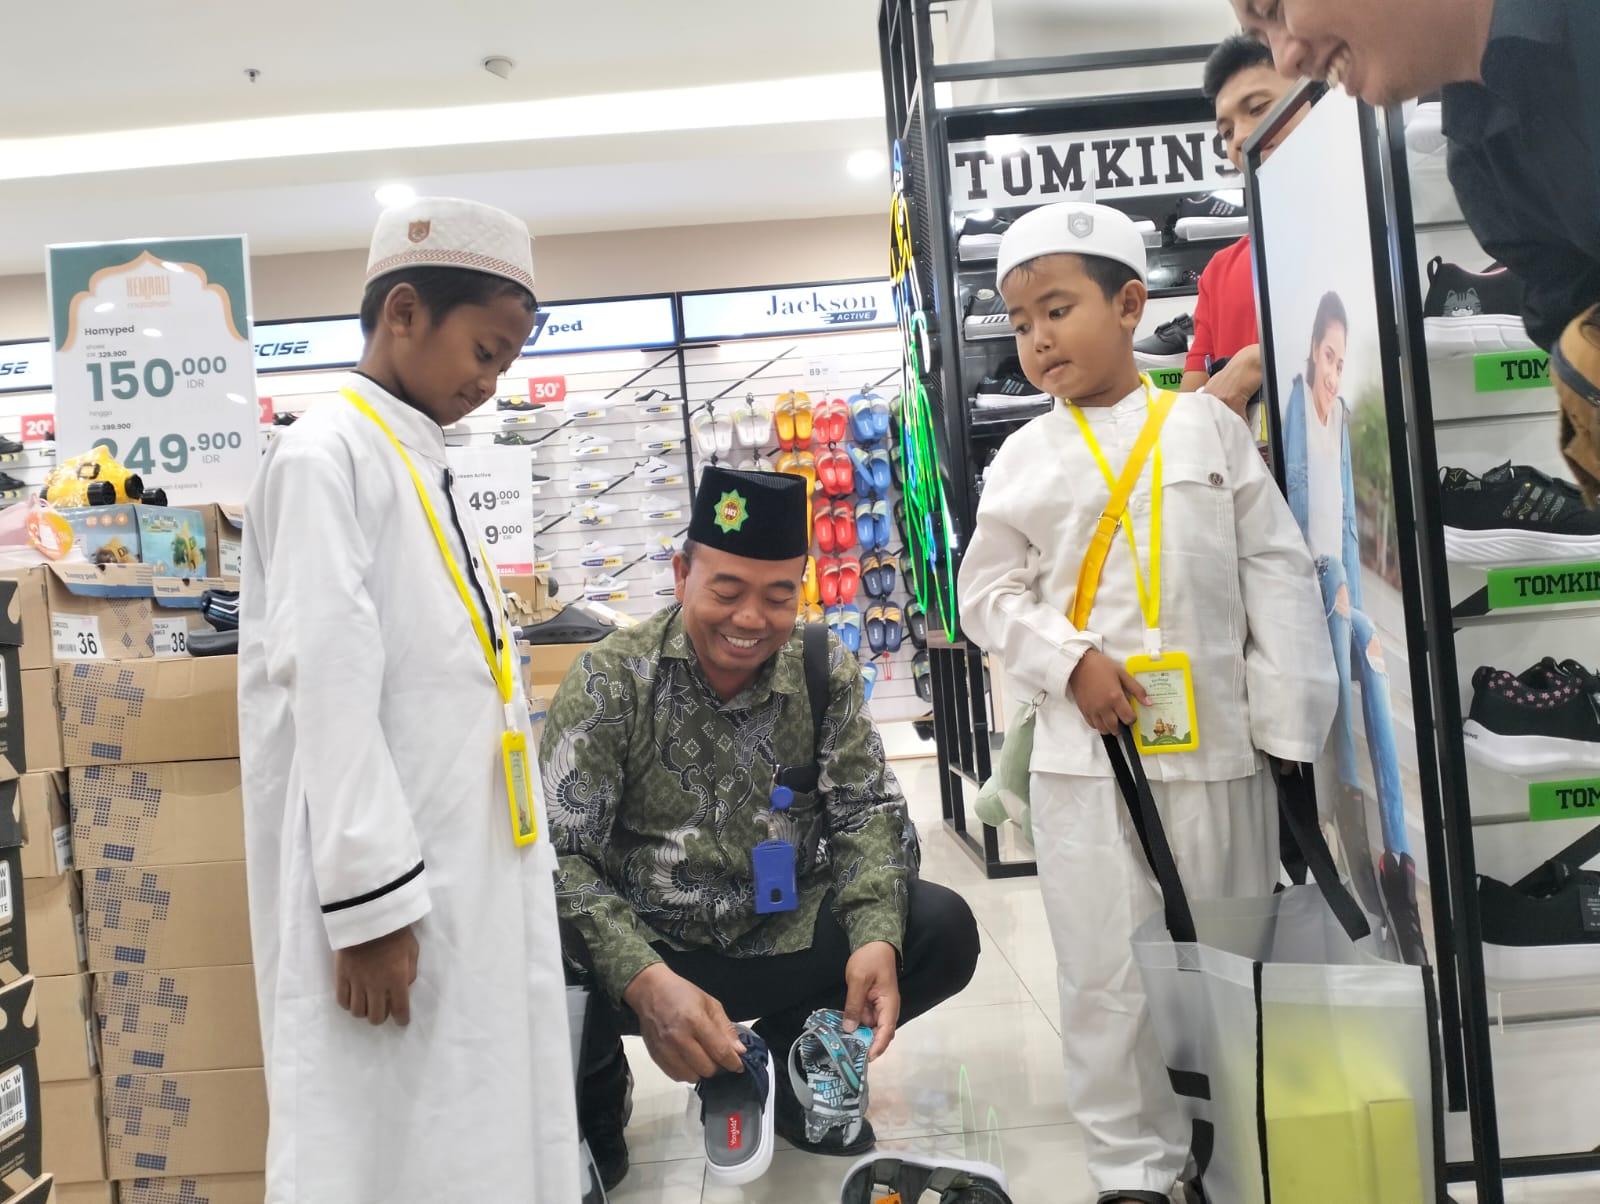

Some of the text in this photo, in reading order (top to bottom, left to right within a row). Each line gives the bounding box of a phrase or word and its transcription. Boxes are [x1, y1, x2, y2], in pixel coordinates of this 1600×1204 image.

[954, 131, 1240, 200] TOMKINS
[767, 292, 876, 315] Jackson
[837, 312, 871, 321] ACTIVE
[84, 325, 135, 336] Homyped
[186, 379, 205, 389] IDR
[202, 455, 221, 464] IDR
[77, 632, 98, 654] 36
[171, 632, 185, 652] 38
